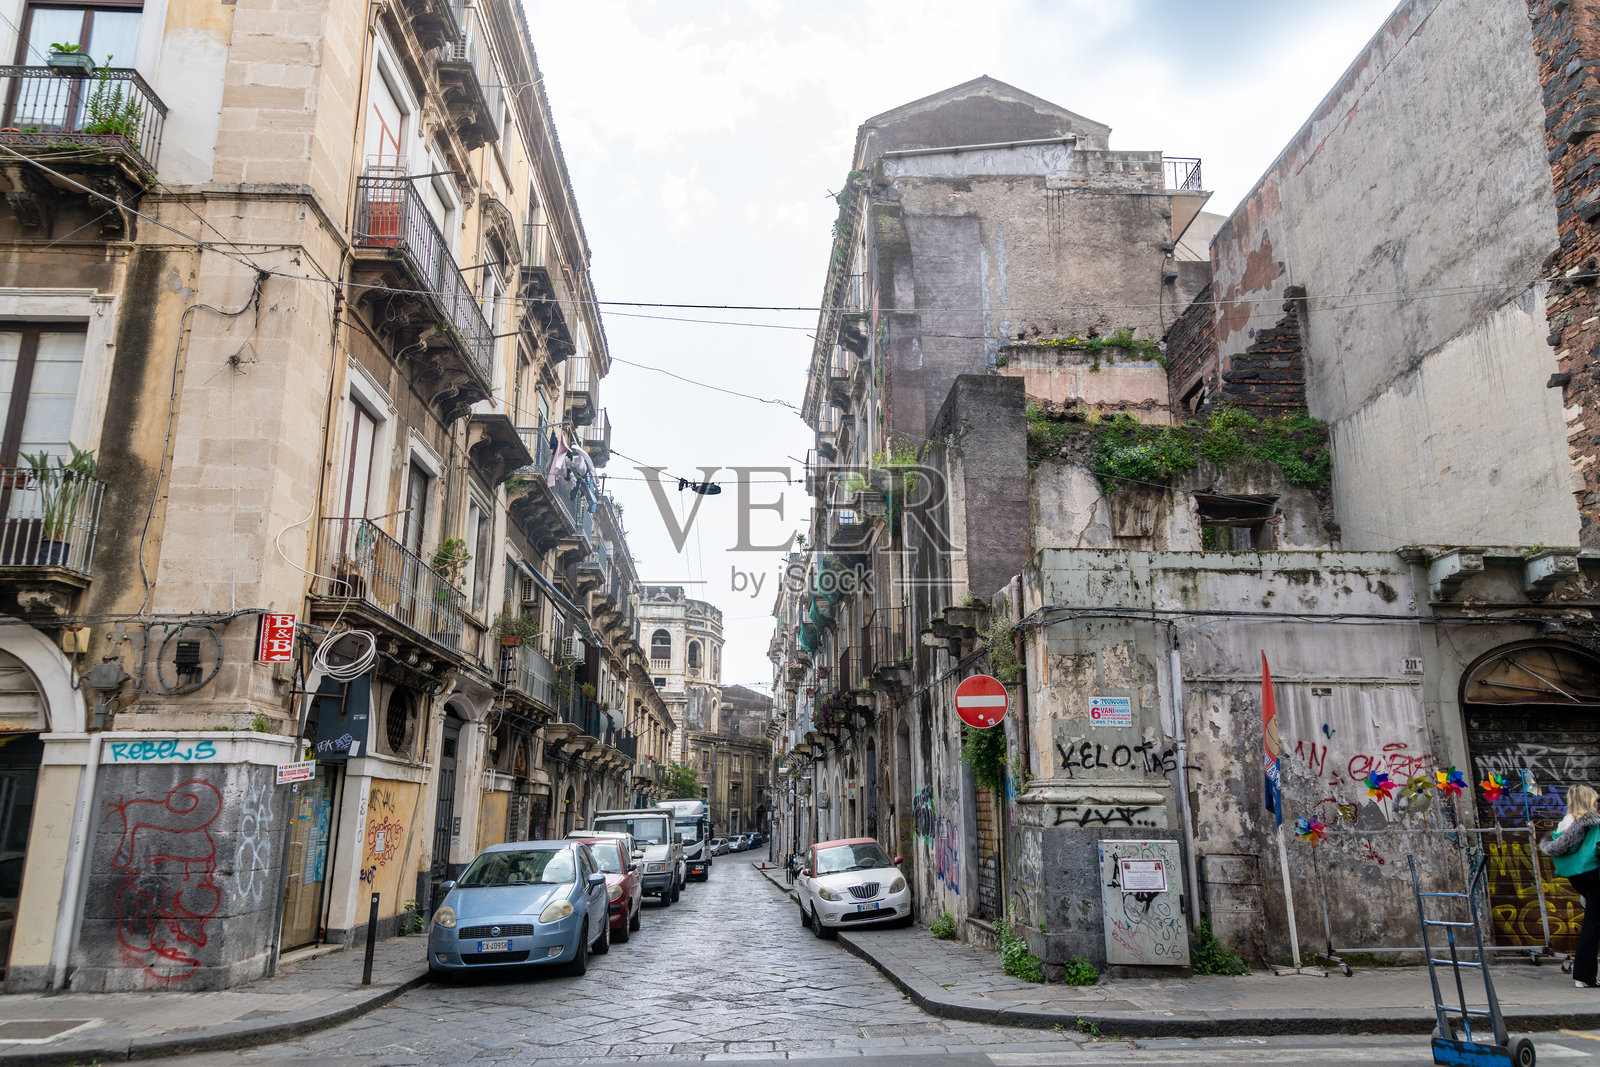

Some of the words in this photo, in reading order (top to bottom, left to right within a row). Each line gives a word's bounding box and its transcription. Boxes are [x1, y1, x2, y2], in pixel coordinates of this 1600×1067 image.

[271, 615, 294, 628] B
[275, 628, 291, 638] &
[269, 639, 292, 652] B
[1091, 708, 1101, 719] 6
